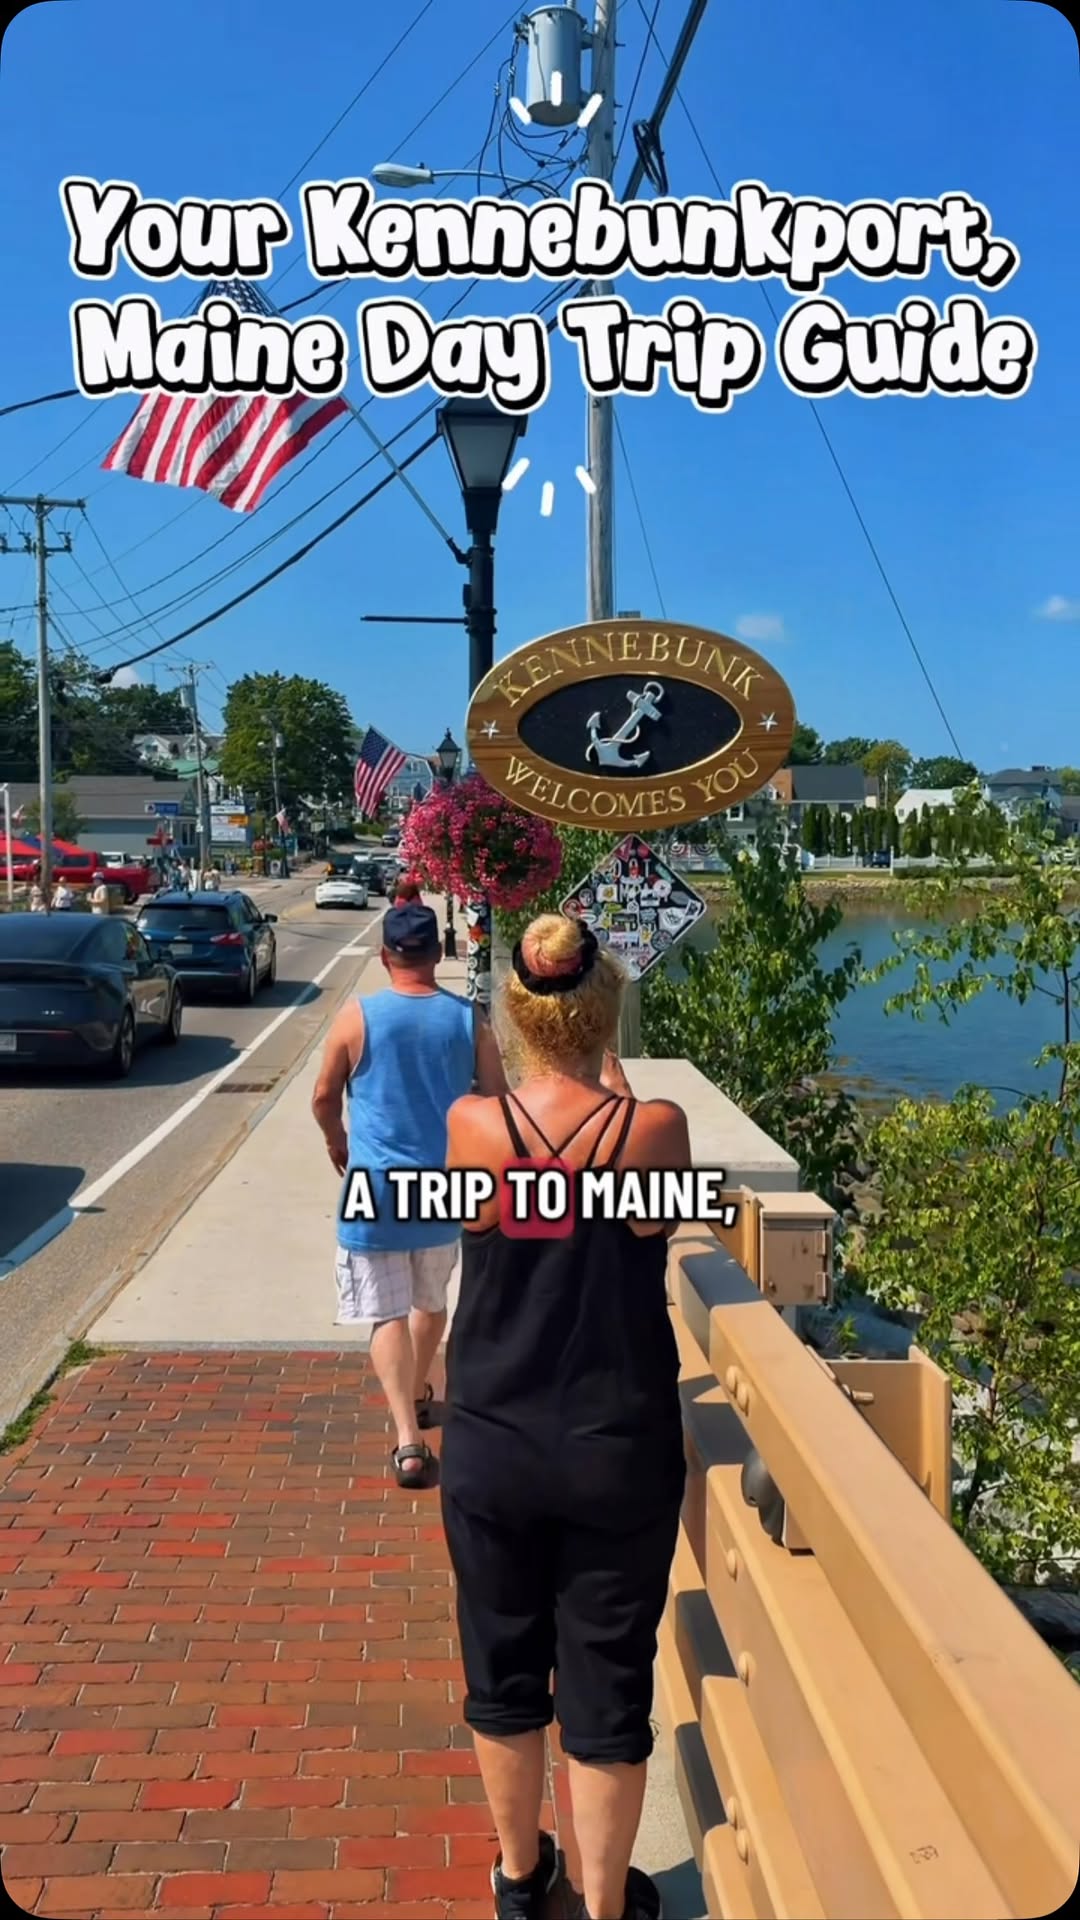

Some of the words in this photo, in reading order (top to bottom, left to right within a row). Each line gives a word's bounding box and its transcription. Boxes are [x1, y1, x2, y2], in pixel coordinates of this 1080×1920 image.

[492, 631, 765, 708] KENNEBUNK
[504, 754, 688, 818] WELCOMES
[692, 747, 760, 804] YOU
